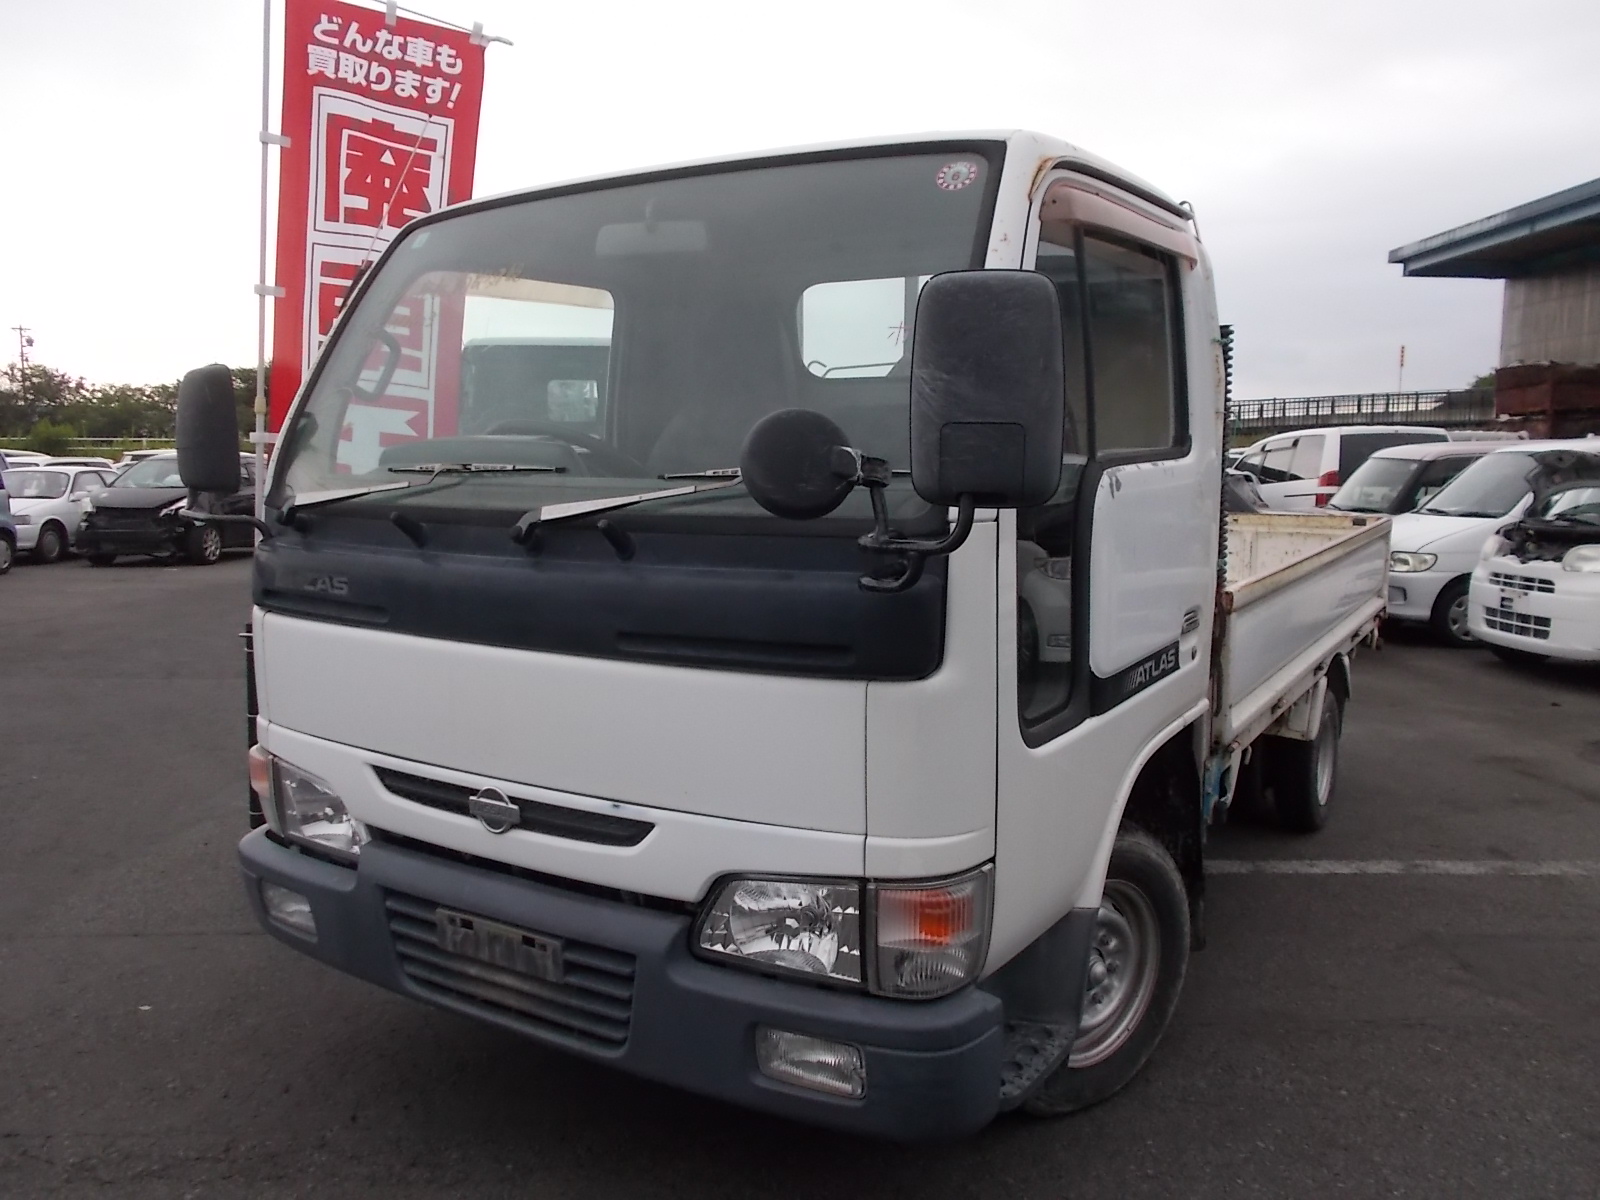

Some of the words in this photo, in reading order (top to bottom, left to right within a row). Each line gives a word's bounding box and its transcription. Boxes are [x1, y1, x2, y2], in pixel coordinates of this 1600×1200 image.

[313, 13, 462, 75] どんな車も
[306, 44, 462, 109] 買取ります!
[1134, 648, 1177, 687] ATLAS
